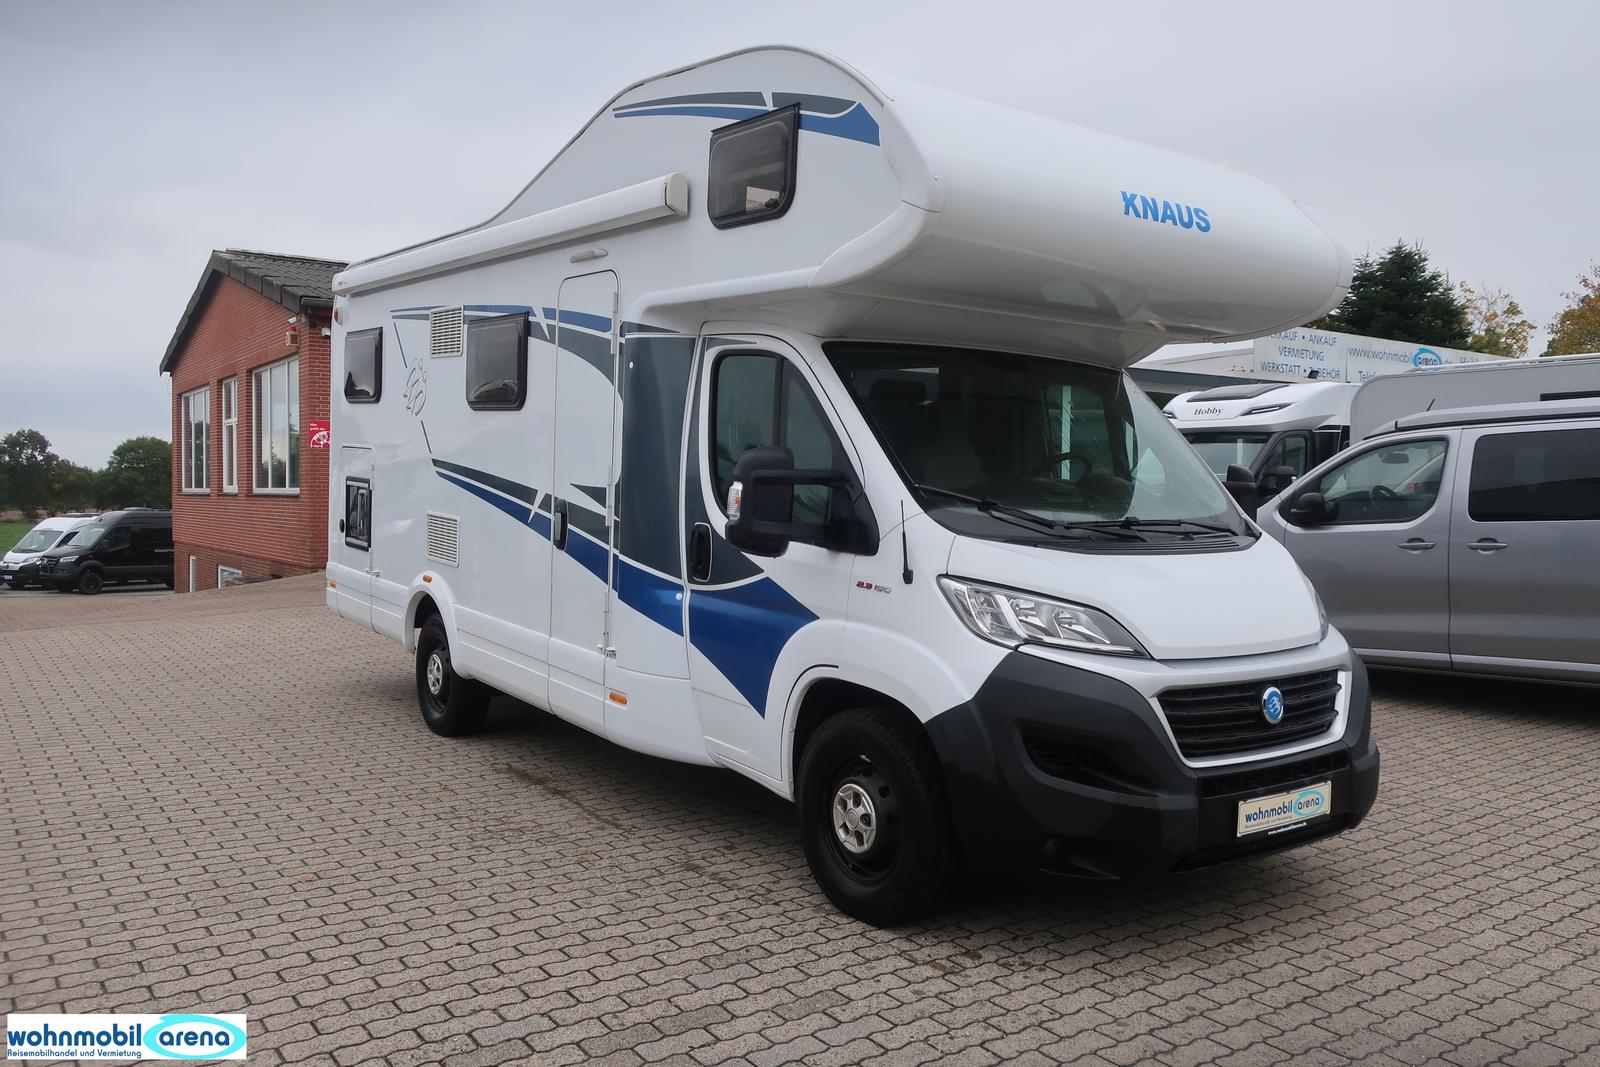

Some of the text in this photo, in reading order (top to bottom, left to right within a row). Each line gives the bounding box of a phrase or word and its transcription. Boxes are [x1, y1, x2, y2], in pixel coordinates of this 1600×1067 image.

[1120, 191, 1211, 233] KNAUS
[1309, 333, 1337, 346] ANKAUF
[1279, 346, 1324, 361] VERMIETUNG
[1260, 361, 1301, 375] WERKSTATT
[1193, 407, 1223, 416] Hobby
[1245, 800, 1293, 823] wohnmobil
[1297, 797, 1320, 810] arena
